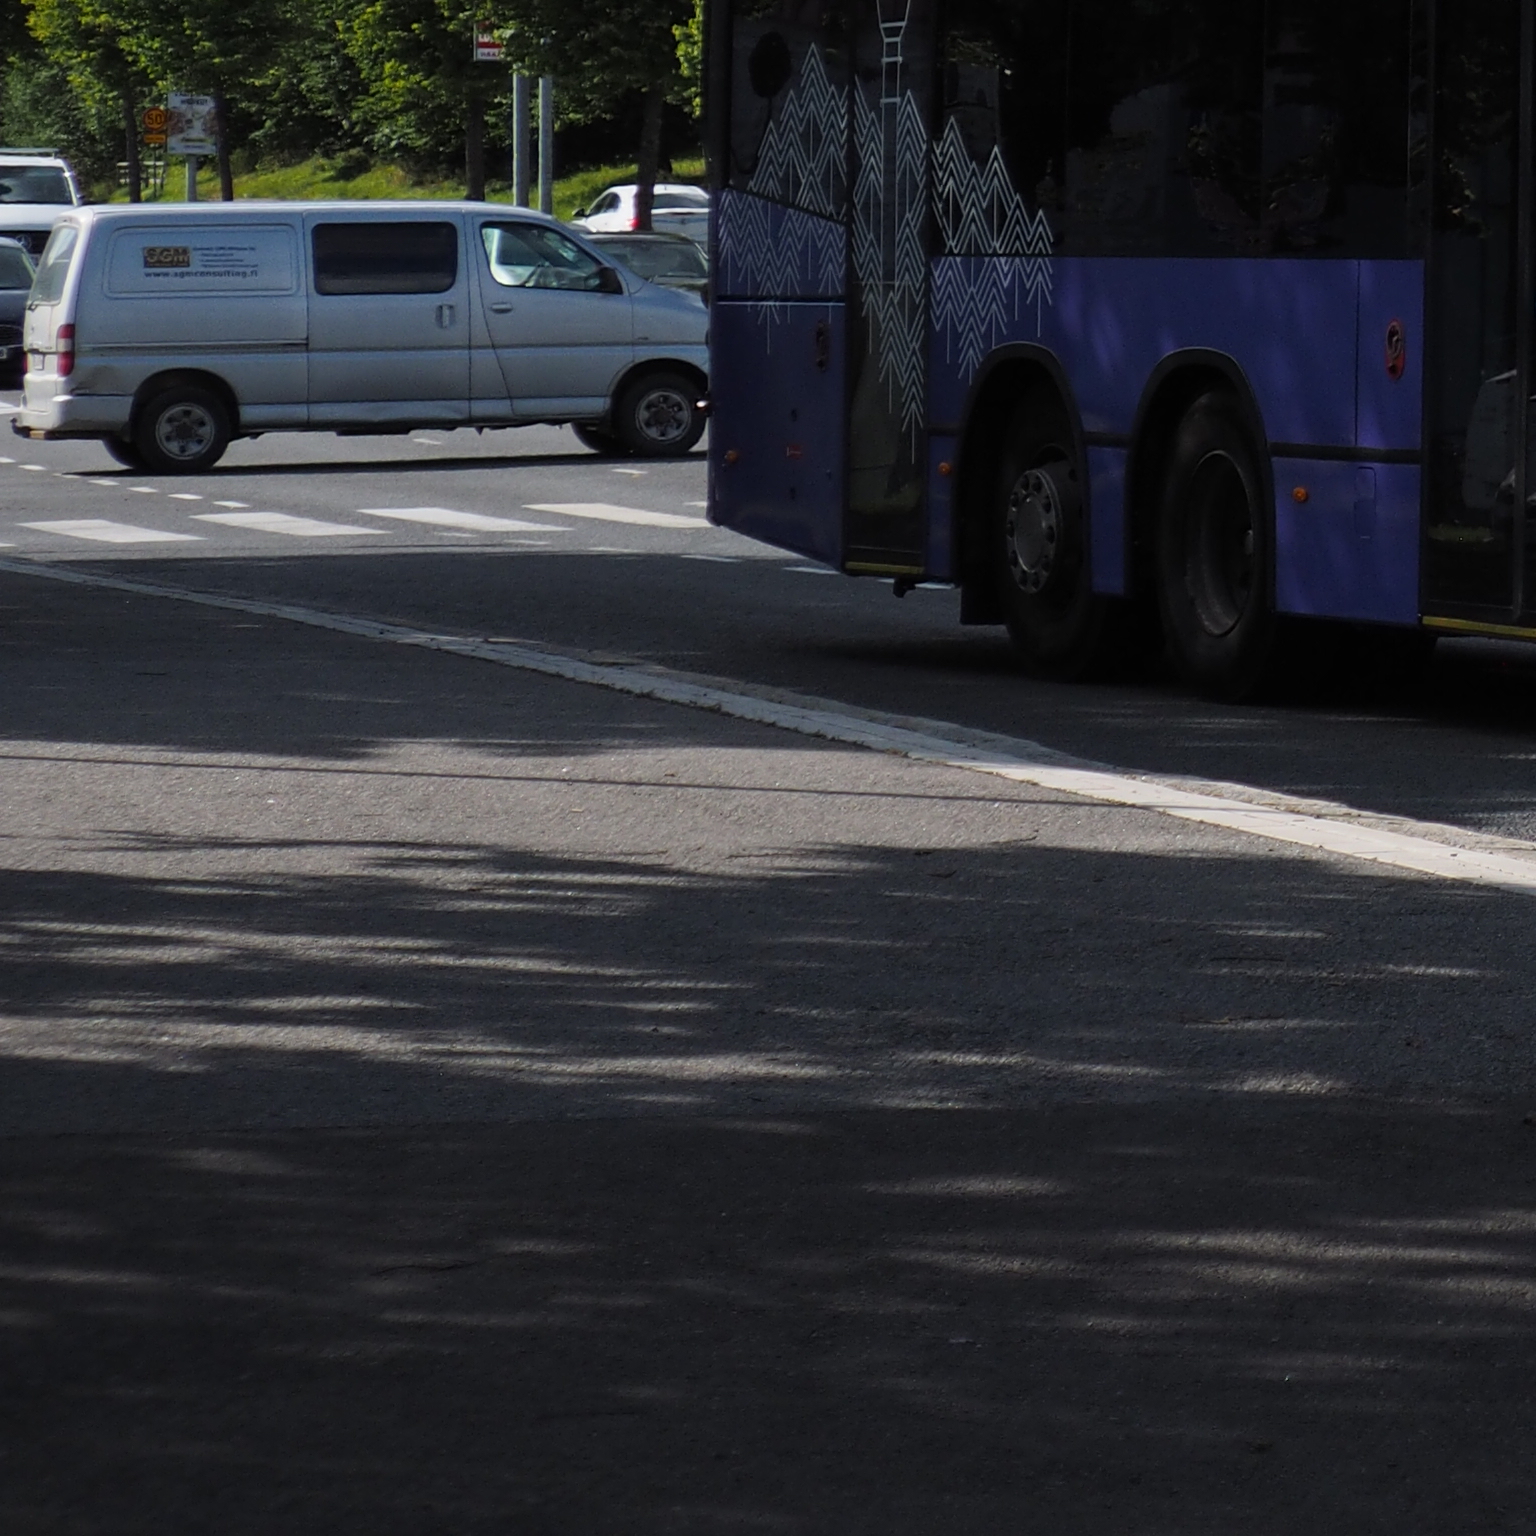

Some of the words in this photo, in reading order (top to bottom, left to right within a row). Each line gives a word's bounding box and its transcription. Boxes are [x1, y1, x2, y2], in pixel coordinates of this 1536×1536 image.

[147, 113, 163, 125] 50
[145, 248, 189, 263] SGM
[144, 269, 258, 279] www.sgmconsulting.fi
